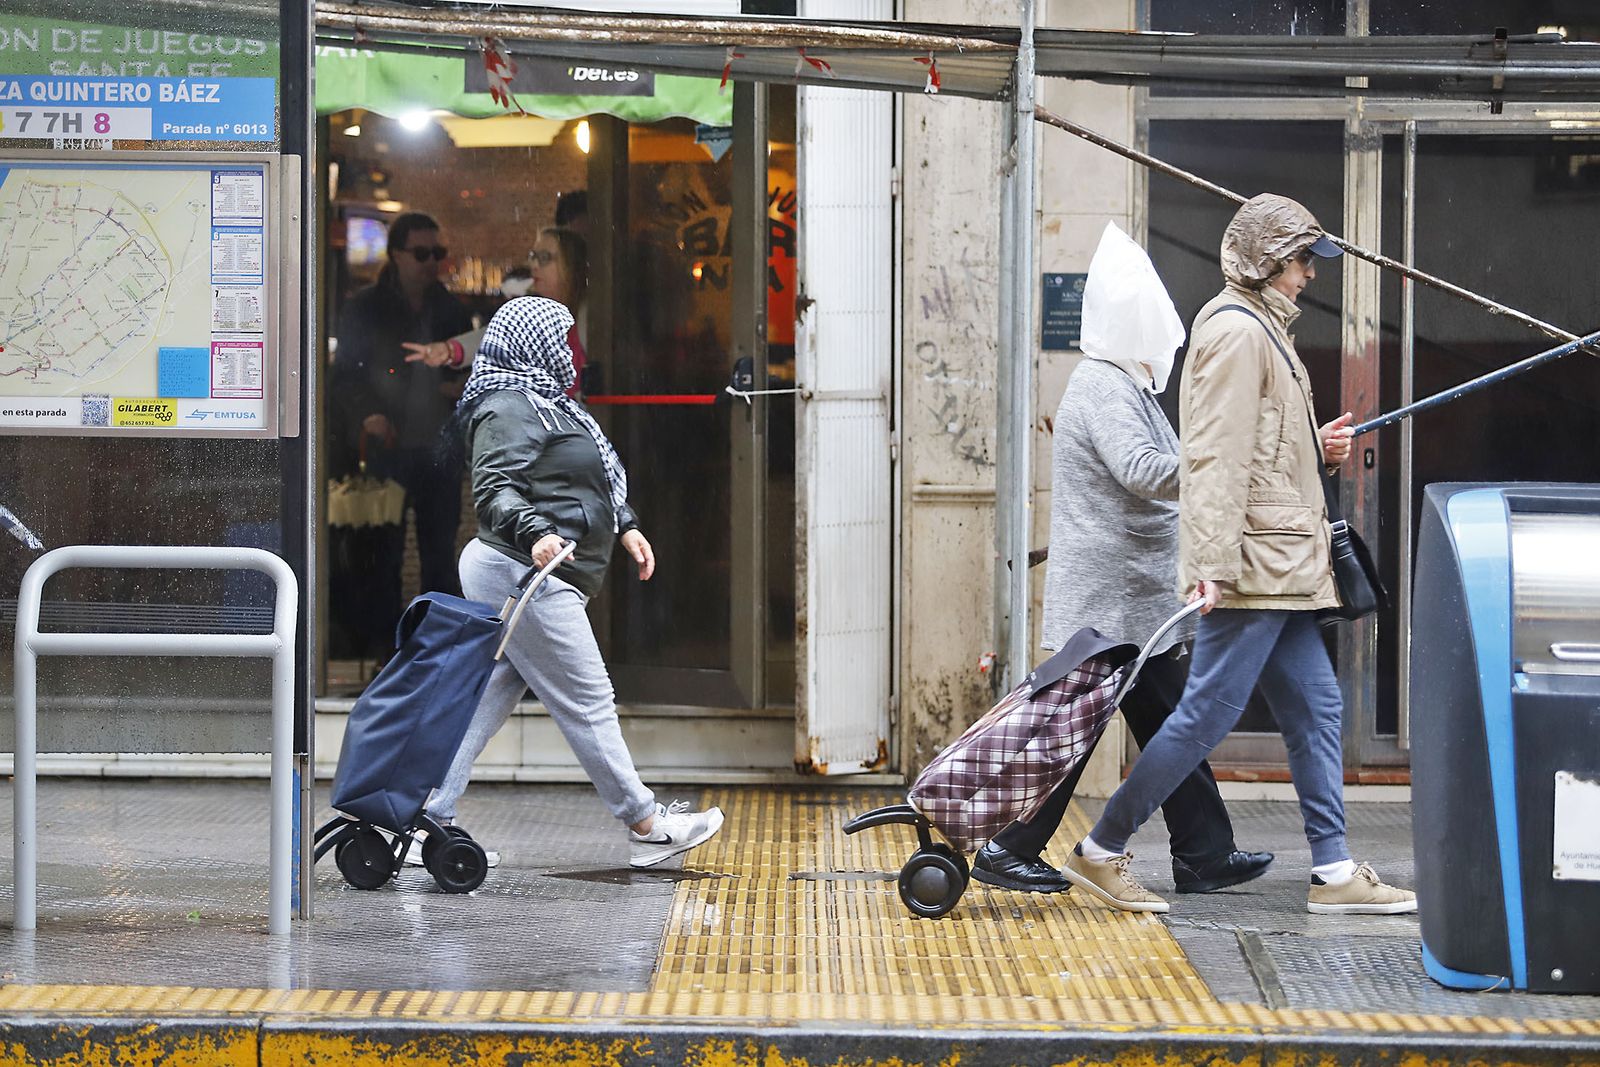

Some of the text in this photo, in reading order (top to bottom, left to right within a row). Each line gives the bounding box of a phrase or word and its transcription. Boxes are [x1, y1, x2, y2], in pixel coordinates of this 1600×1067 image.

[52, 28, 103, 53] DE
[112, 29, 267, 56] JUEGOS
[30, 81, 152, 102] QUINTERO
[159, 79, 220, 103] BÁEZ
[15, 112, 32, 132] 7
[43, 112, 82, 133] 7H
[94, 113, 111, 134] 8
[163, 123, 212, 134] Parada
[233, 124, 268, 135] 6013
[15, 408, 34, 416] esta
[35, 408, 67, 418] parada
[118, 404, 168, 412] GILABERT
[214, 411, 257, 419] EMTUSA
